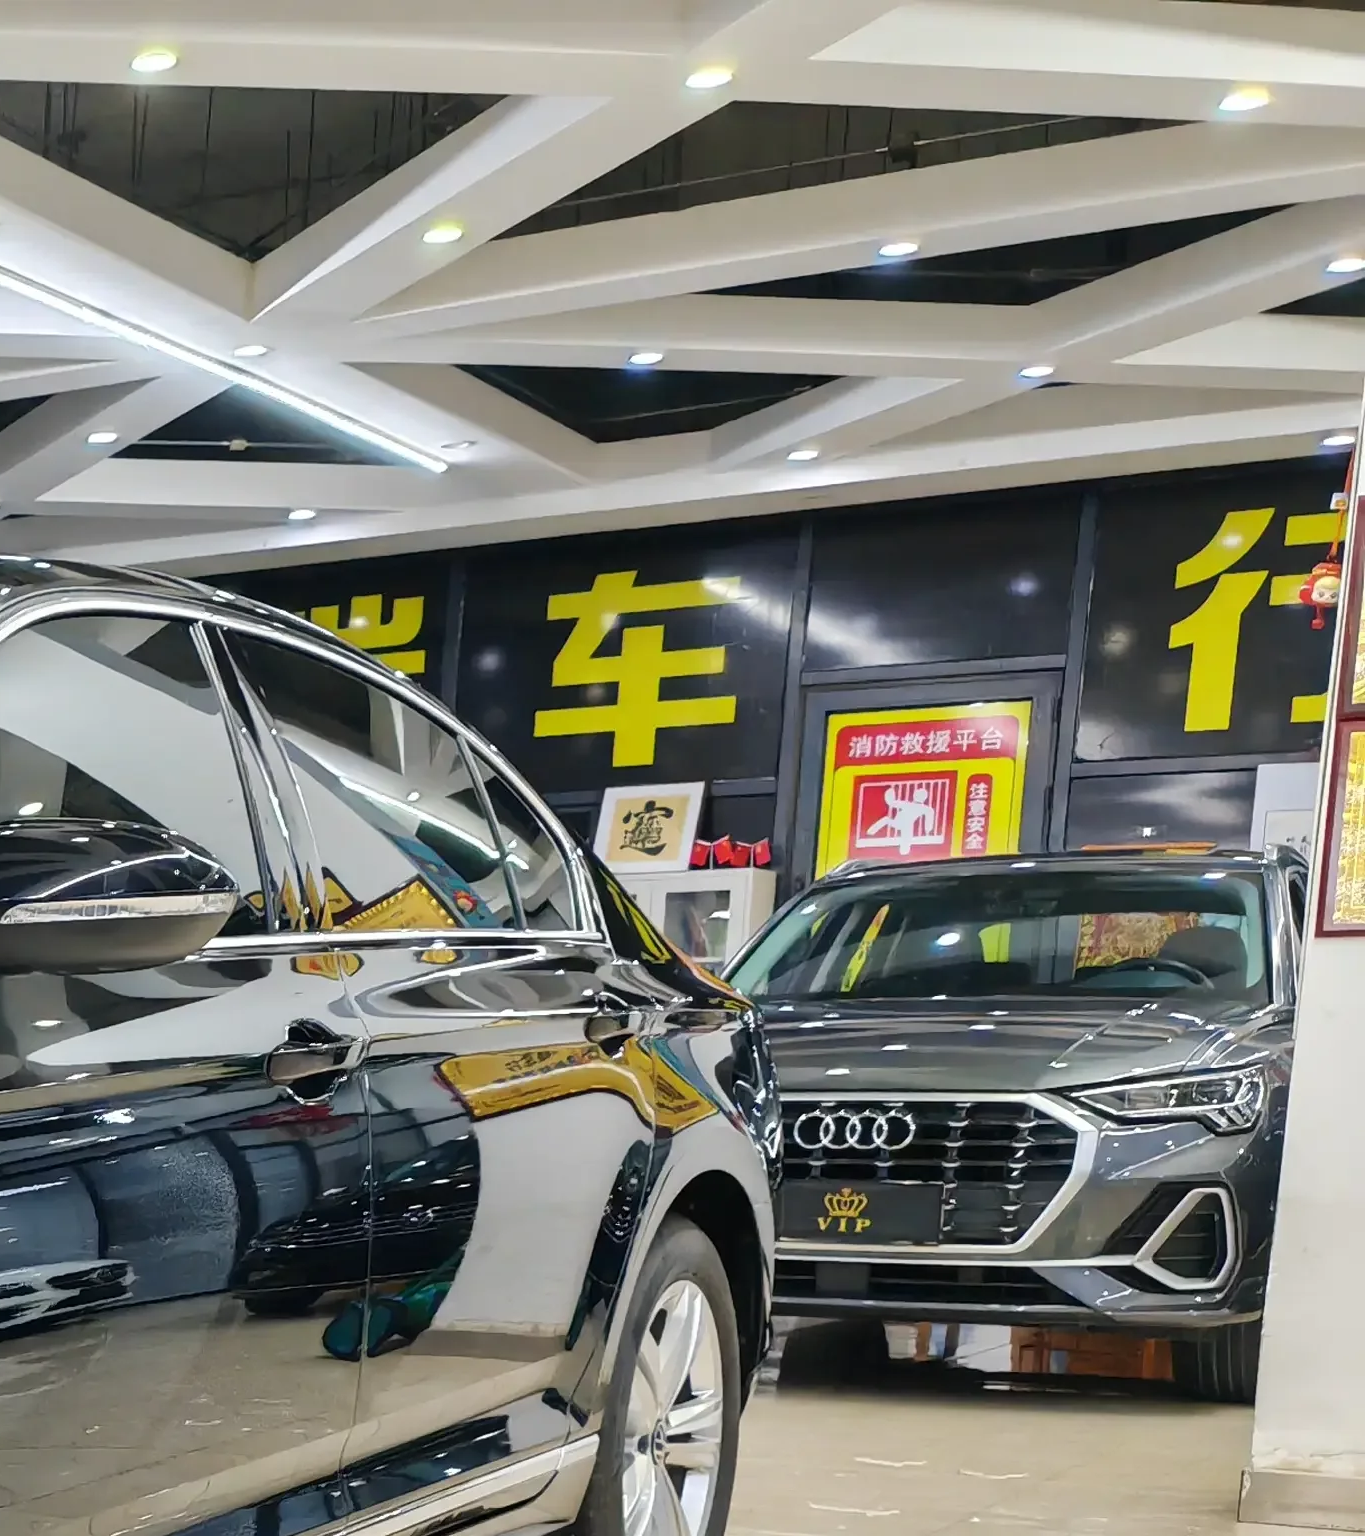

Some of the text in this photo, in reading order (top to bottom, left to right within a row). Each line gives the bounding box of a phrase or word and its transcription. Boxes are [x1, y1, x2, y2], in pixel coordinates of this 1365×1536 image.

[848, 726, 1004, 758] 消防救援平台
[965, 782, 990, 850] 注意安全
[817, 1217, 872, 1233] VIP
